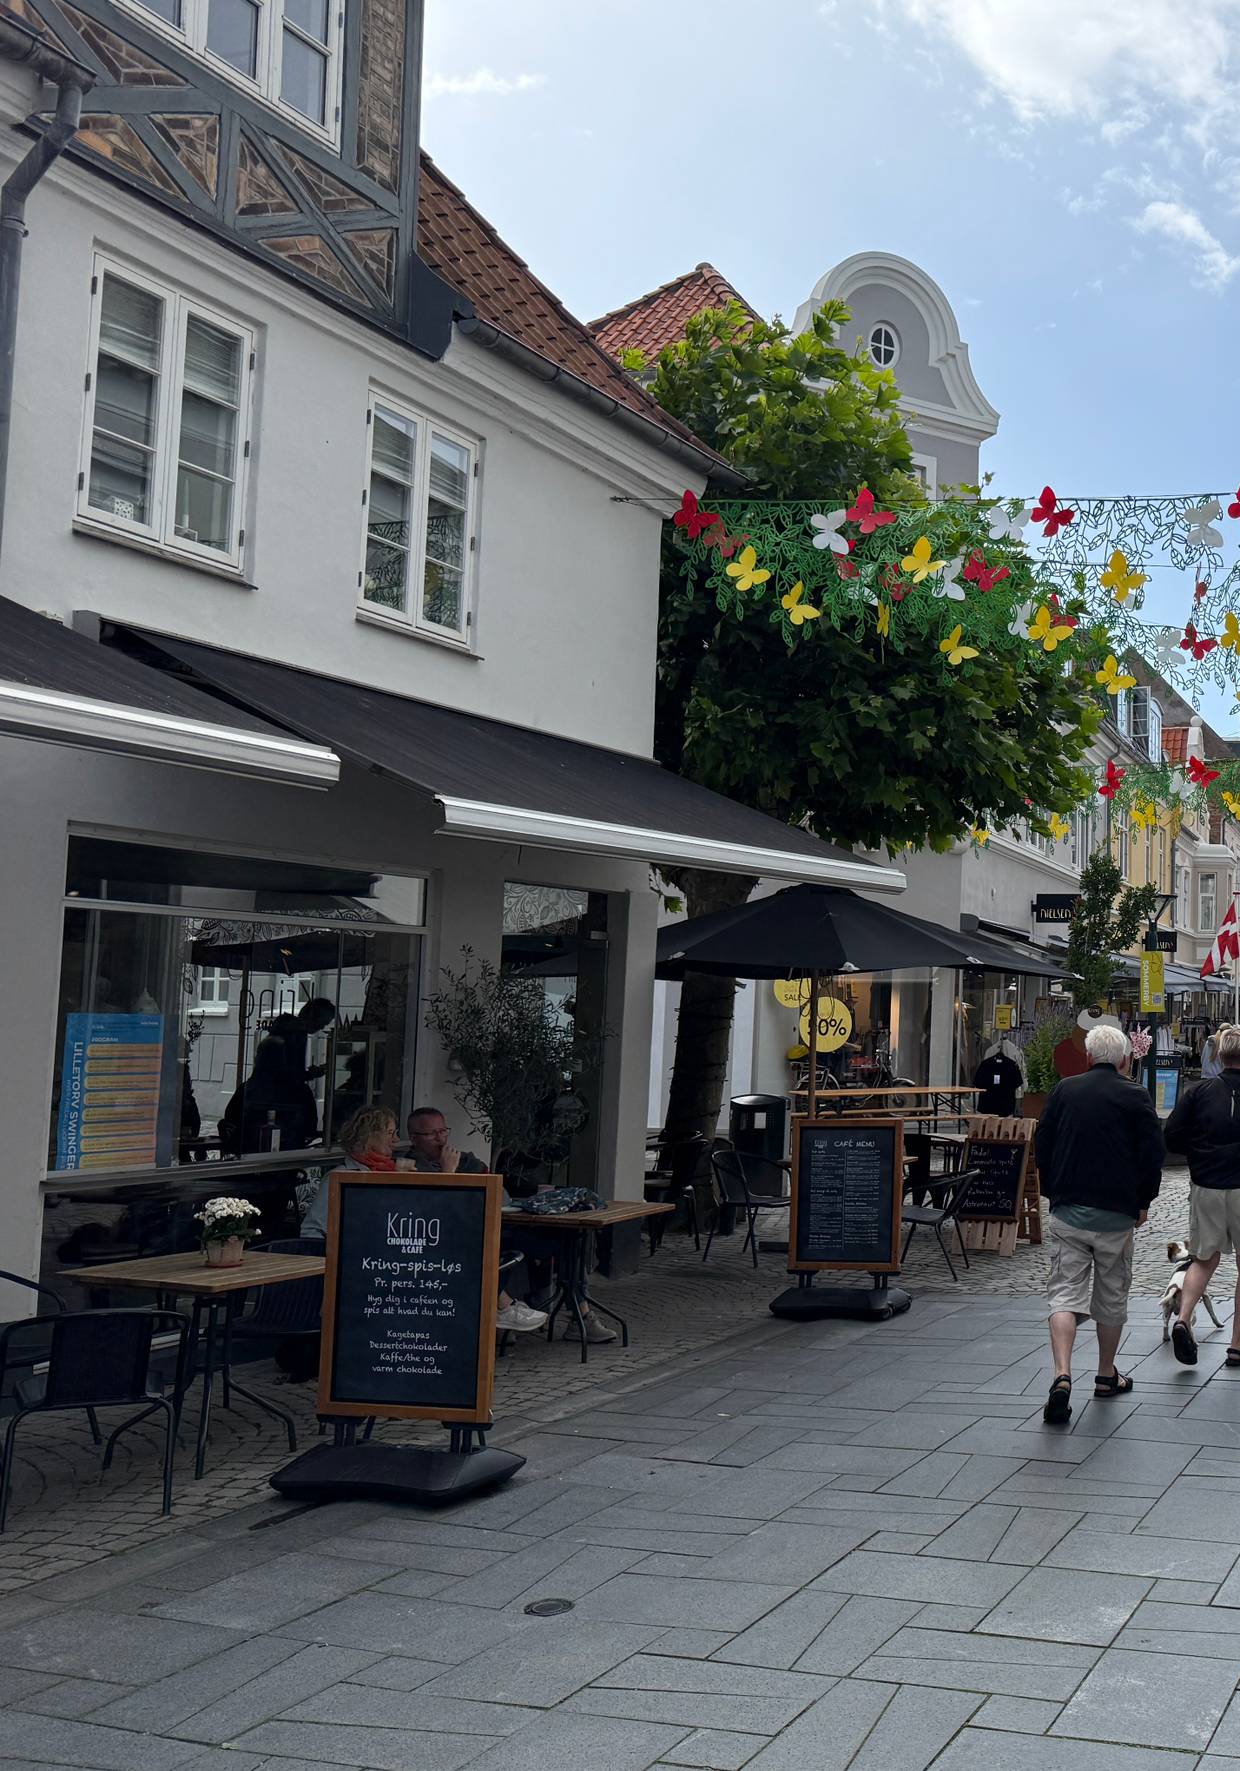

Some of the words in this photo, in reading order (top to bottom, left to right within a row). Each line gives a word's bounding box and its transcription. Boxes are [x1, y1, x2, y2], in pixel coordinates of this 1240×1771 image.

[71, 1041, 84, 1109] LILLETORV
[833, 1138, 854, 1148] CAFÉ
[387, 1211, 440, 1246] Kring
[386, 1238, 427, 1246] CHOKOLADE
[362, 1257, 462, 1279] Kring-spis-løs
[374, 1277, 388, 1287] Pr.
[391, 1280, 416, 1292] pers.
[367, 1294, 382, 1306] Hyg
[385, 1294, 400, 1306] dig
[410, 1294, 438, 1306] caféen
[442, 1299, 454, 1308] og
[363, 1307, 380, 1318] spis
[383, 1306, 395, 1315] alt
[398, 1306, 419, 1315] hvad
[421, 1307, 433, 1316] du
[436, 1308, 456, 1317] kan!
[386, 1330, 430, 1343] Kagetapas
[369, 1340, 448, 1352] Dessertchokolader
[423, 1356, 435, 1366] og
[396, 1364, 444, 1375] chokolade
